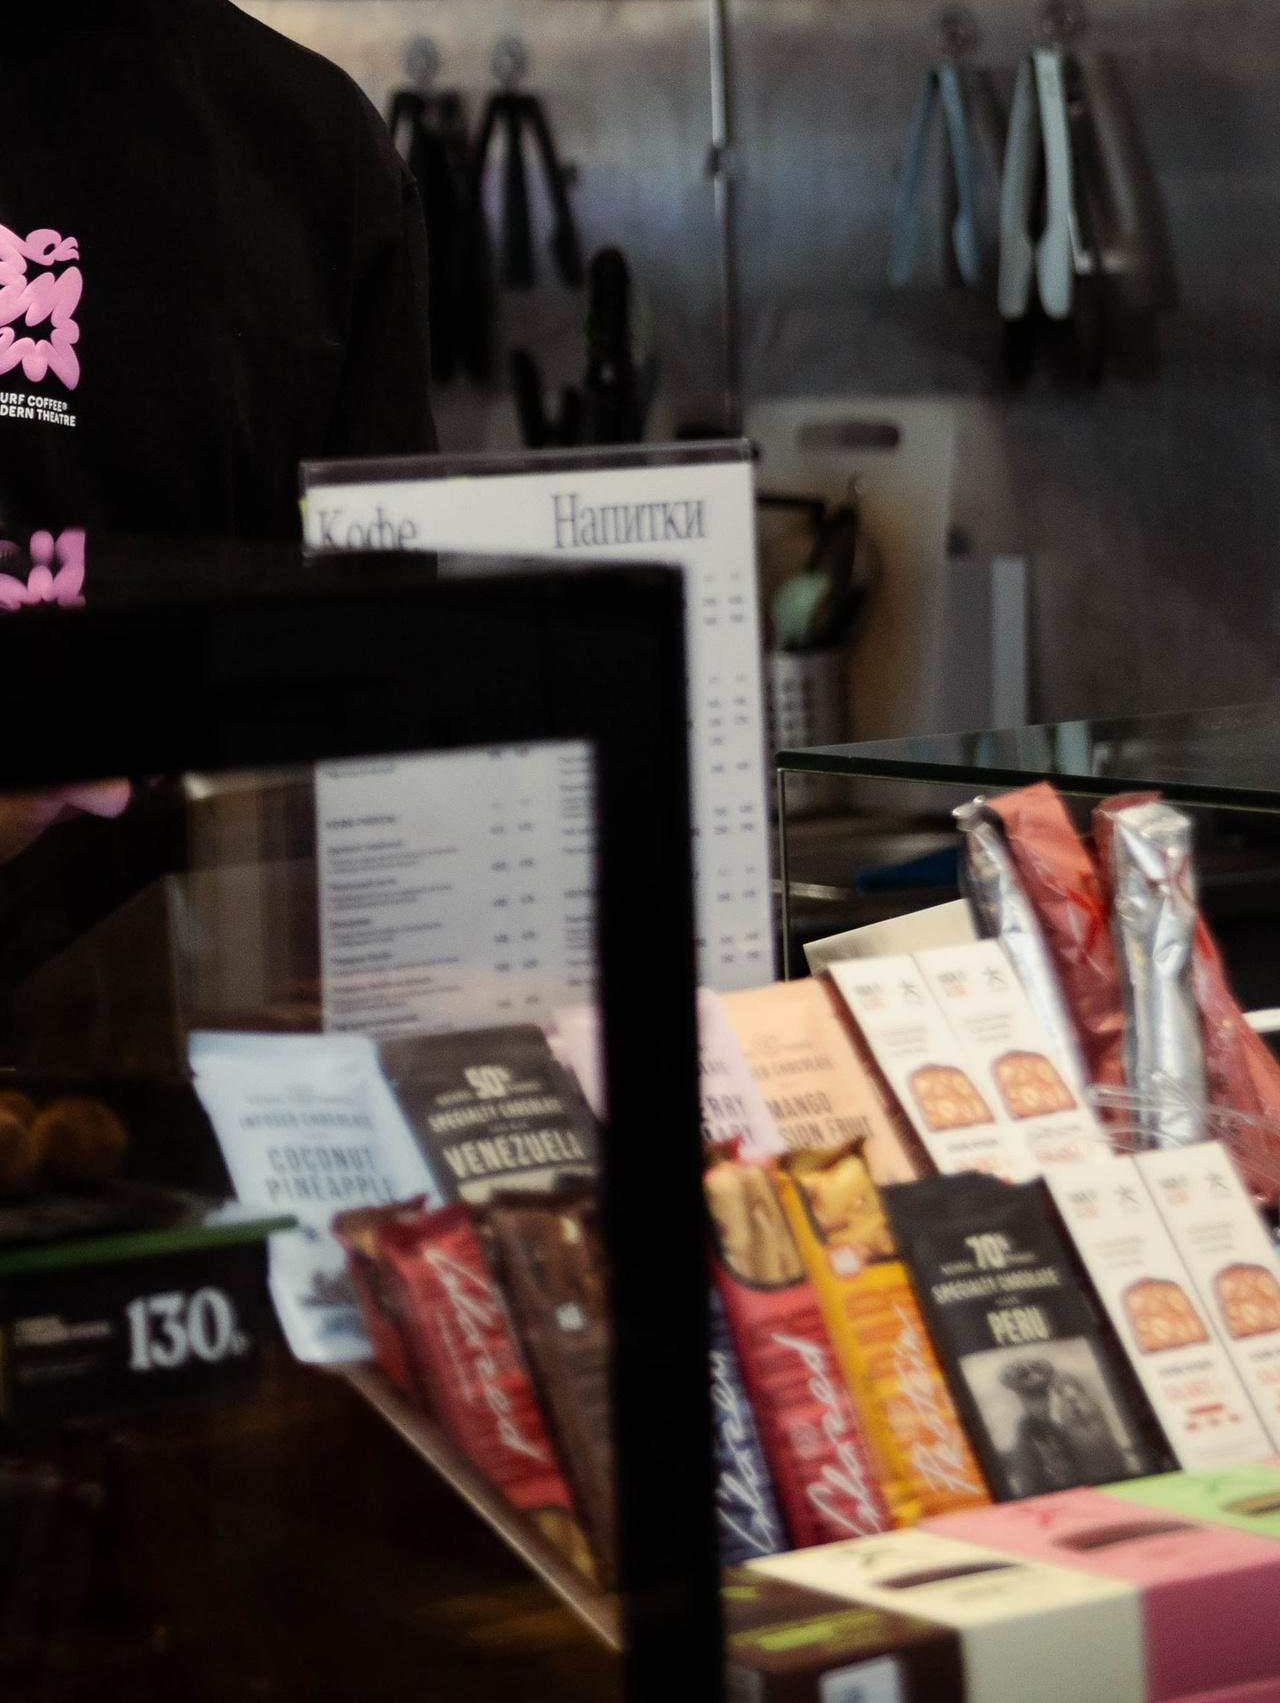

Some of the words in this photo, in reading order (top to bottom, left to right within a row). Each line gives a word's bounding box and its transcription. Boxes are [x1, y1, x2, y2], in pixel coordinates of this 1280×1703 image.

[36, 408, 76, 427] THEATRE
[316, 505, 418, 549] Кофе
[550, 492, 708, 549] Напитки
[765, 1089, 832, 1120] MANGO
[267, 1146, 375, 1172] COCONUT
[441, 1128, 587, 1179] VENEZUELA
[986, 1305, 1050, 1344] PERU
